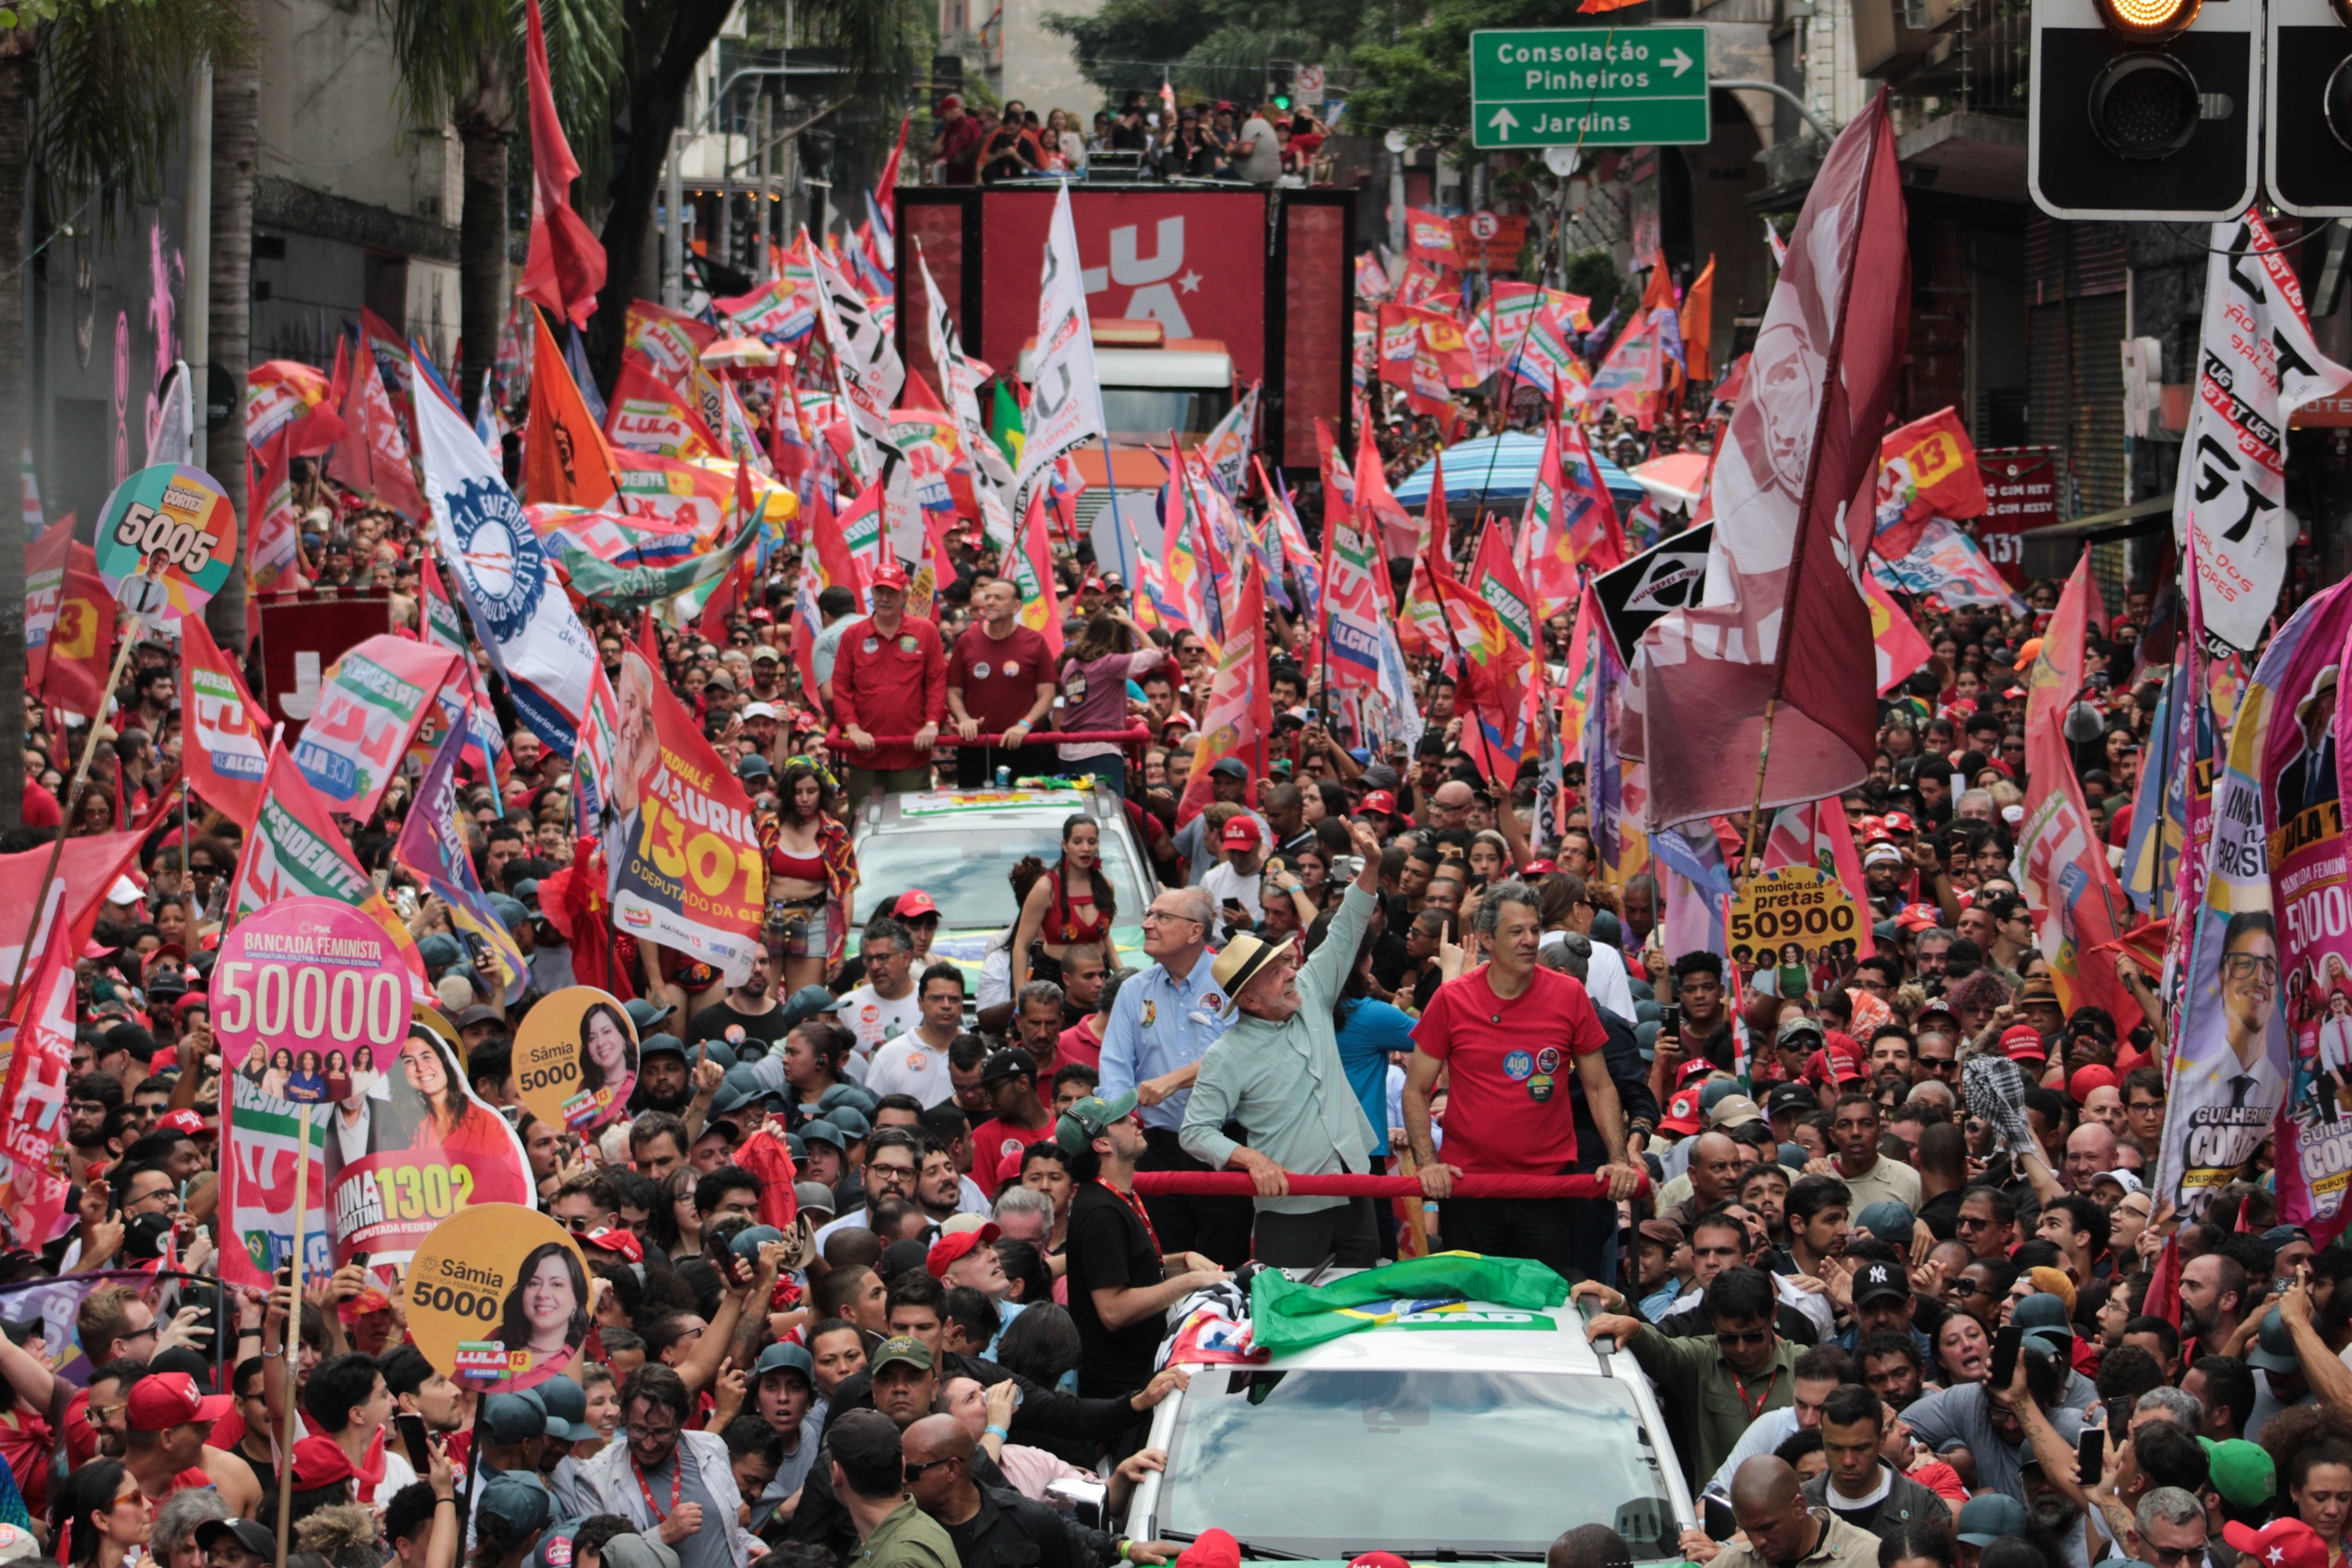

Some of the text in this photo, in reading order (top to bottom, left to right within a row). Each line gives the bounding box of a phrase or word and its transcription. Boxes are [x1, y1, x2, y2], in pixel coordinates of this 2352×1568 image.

[1526, 70, 1650, 90] Pinheiros
[1532, 113, 1632, 133] Jardins
[618, 415, 683, 435] LULA
[1909, 437, 1947, 477] 13
[162, 489, 205, 514] CORTEZ
[166, 483, 207, 500] GUILHERME
[478, 494, 535, 546] ENERGIA
[114, 501, 220, 573] 5005
[2216, 553, 2255, 593] DOS
[1632, 568, 1700, 606] MULHERES VIVAS
[558, 629, 577, 647] de
[701, 772, 715, 792] É
[1225, 829, 1245, 838] LULA
[630, 862, 641, 873] O
[641, 867, 710, 911] DEPUTADO
[712, 904, 735, 917] DA
[1754, 880, 1824, 894] monica das
[1753, 889, 1825, 914] pretas
[1731, 905, 1855, 941] 50900
[244, 932, 314, 956] BANCADA
[245, 950, 287, 960] CANDIDATURA
[351, 960, 380, 968] ESTADUAL
[220, 961, 402, 1044] 50000
[530, 1042, 574, 1063] Sâmia
[1507, 1056, 1529, 1071] 400
[520, 1062, 578, 1092] 5000
[563, 1089, 608, 1118] LULA 13
[2195, 1105, 2273, 1125] GUILHERME
[334, 1169, 379, 1226] LUNA
[374, 1164, 474, 1221] 1302
[353, 1224, 401, 1243] DEPUTADA
[416, 1273, 500, 1298] DEPUTADA FEDERAL PSOL
[439, 1259, 503, 1288] Sâmia
[412, 1282, 498, 1322] 5000
[456, 1352, 528, 1367] LULA 13
